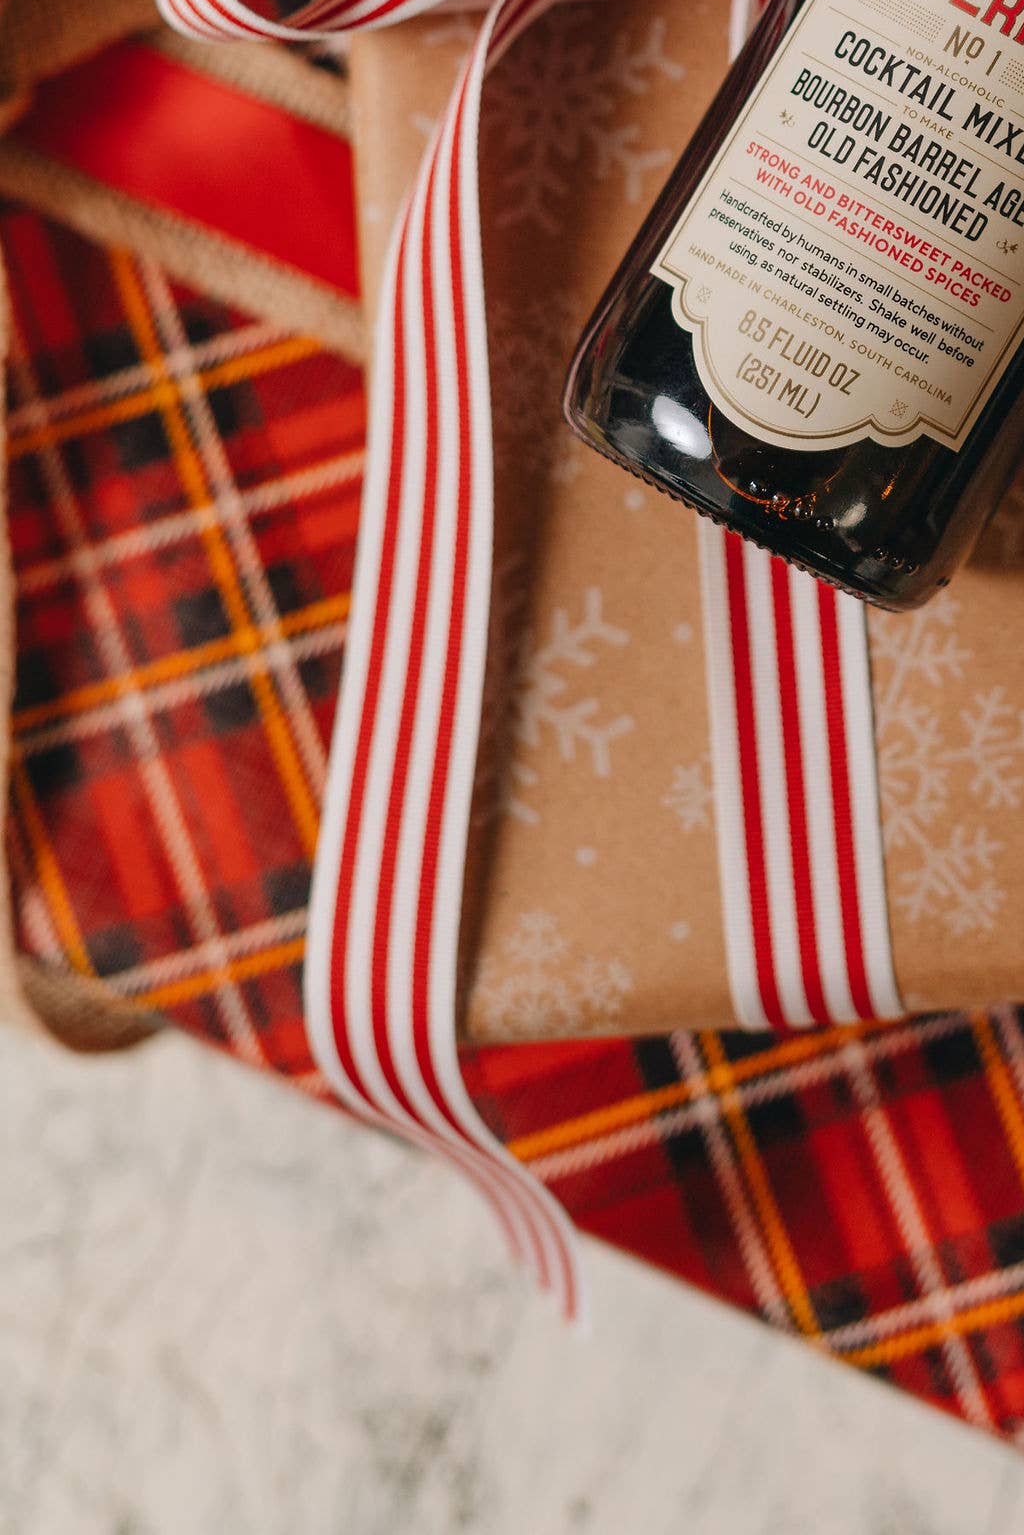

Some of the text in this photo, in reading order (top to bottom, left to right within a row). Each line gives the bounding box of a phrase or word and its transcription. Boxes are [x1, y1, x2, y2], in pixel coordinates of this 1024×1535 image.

[834, 30, 956, 122] COCKTAIL
[903, 104, 954, 141] TO MAKE
[906, 46, 1005, 108] NON-ALCOHOLIC
[985, 50, 1002, 77] 1
[790, 68, 892, 143] BOURBON
[886, 122, 982, 199] BARREL
[807, 121, 989, 242] OLD FASHIONED
[719, 189, 985, 352] Handcrafted by humans in small batches without
[746, 141, 1012, 303] STRONG AND BITTERSWEET PACKED
[756, 167, 981, 307] WITH OLD FASHIONED SPICES
[688, 245, 952, 404] HAND MADE IN CHARLESTON, SOUTH CAROLINA
[708, 208, 975, 368] preservatives nor stabilizers. Shake well before
[729, 241, 930, 365] using, as natural settling may occur.
[735, 352, 821, 419] (251 ML)
[737, 309, 861, 396] 8.5 FLUID OZ
